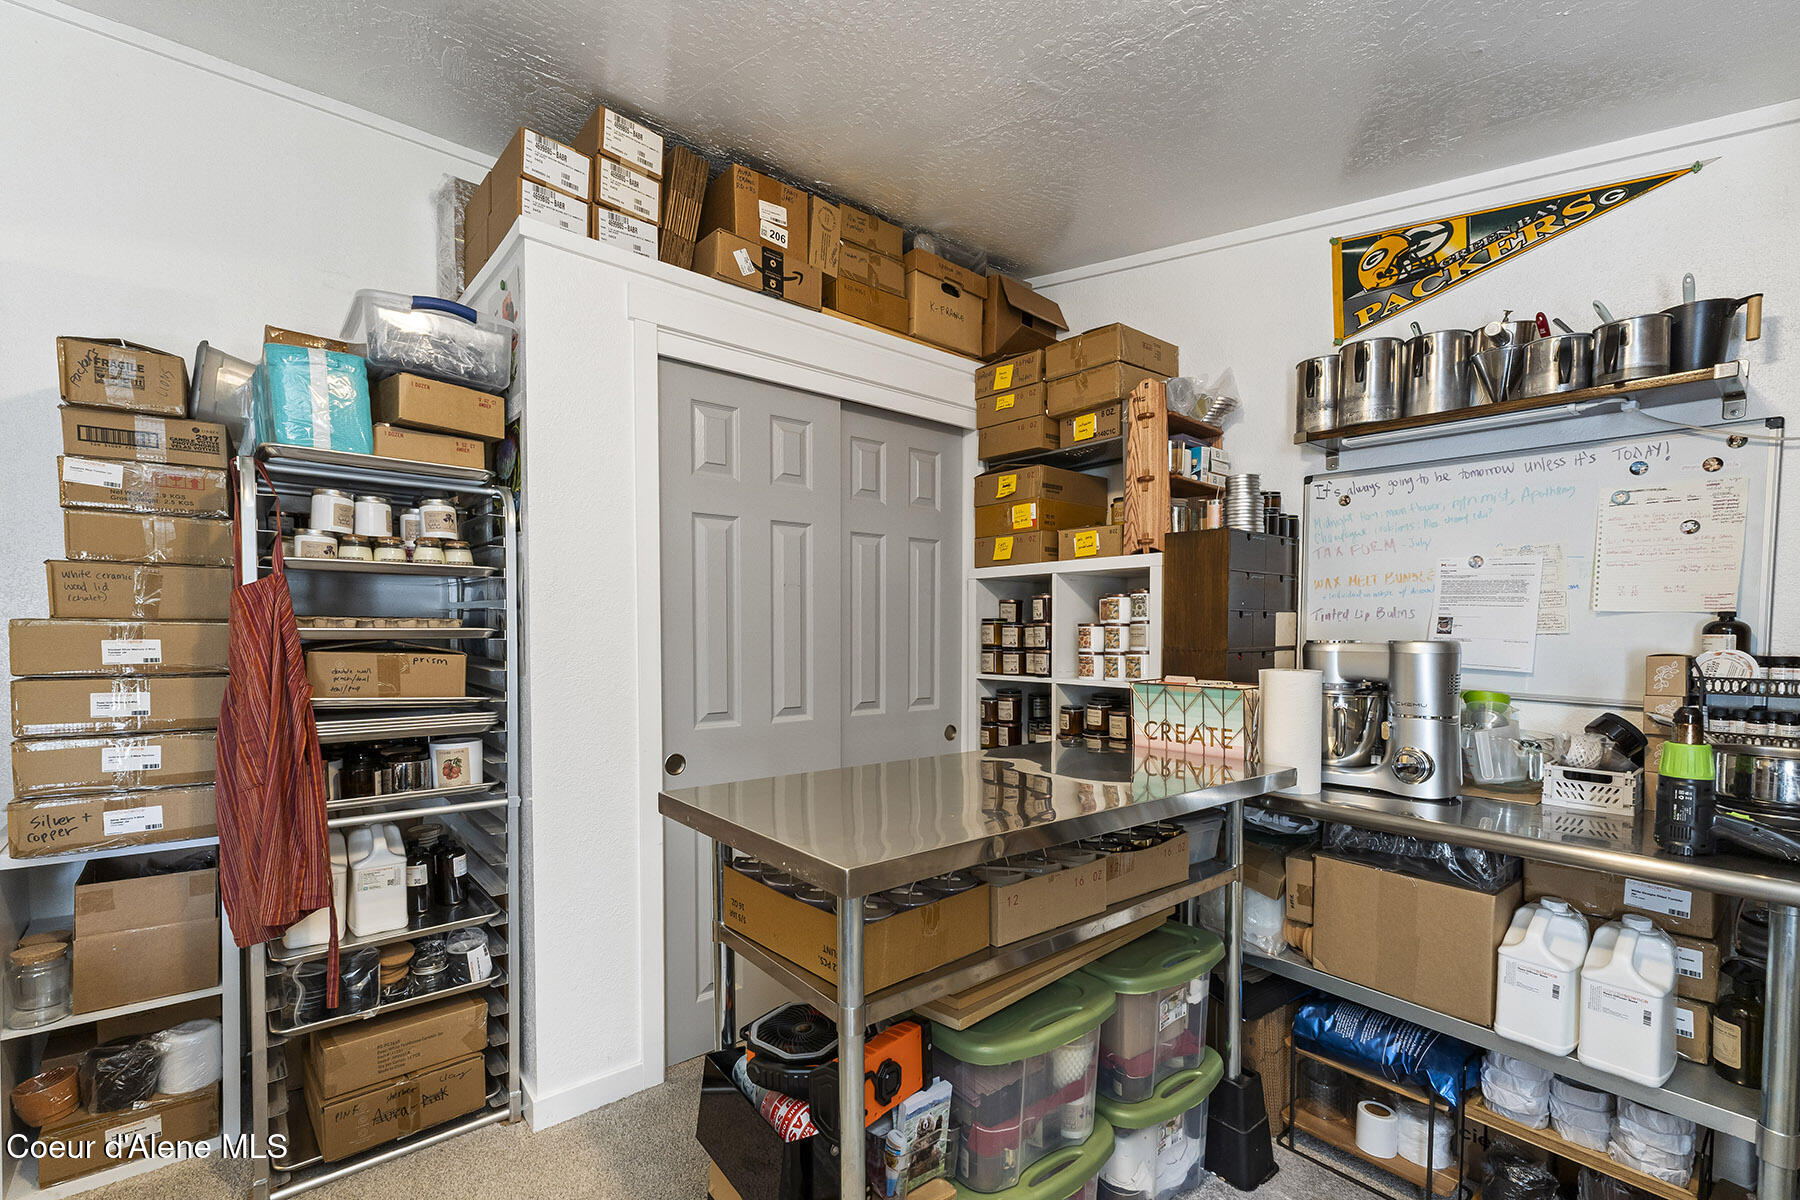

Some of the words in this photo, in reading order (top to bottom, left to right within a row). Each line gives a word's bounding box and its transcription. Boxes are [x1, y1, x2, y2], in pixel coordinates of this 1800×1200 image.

[769, 229, 786, 244] 206
[1439, 225, 1513, 270] GREEN
[1516, 199, 1562, 229] BAY
[1353, 194, 1596, 330] PACKERS
[93, 357, 145, 373] FRAGILE
[195, 434, 219, 442] 2917
[1313, 480, 1341, 500] It's
[1347, 481, 1381, 498] always
[1387, 477, 1415, 496] going
[1416, 473, 1430, 486] to
[1434, 471, 1451, 482] be
[1457, 462, 1515, 480] tomorrow
[1523, 456, 1567, 473] unless
[1573, 453, 1597, 466] it's
[1611, 441, 1671, 462] TODAY!
[1312, 546, 1344, 559] TAX
[95, 572, 133, 581] ceramic
[1313, 575, 1341, 590] WAX
[1348, 573, 1378, 587] MELT
[1311, 607, 1349, 622] Tinted
[1354, 608, 1371, 621] Lip
[1376, 606, 1416, 621] Balms
[412, 656, 449, 666] prism
[1143, 720, 1233, 750] CREATE
[30, 814, 76, 829] Silver
[82, 812, 93, 823] +
[26, 826, 79, 843] copper
[1007, 894, 1020, 908] 12
[1074, 876, 1085, 887] 16
